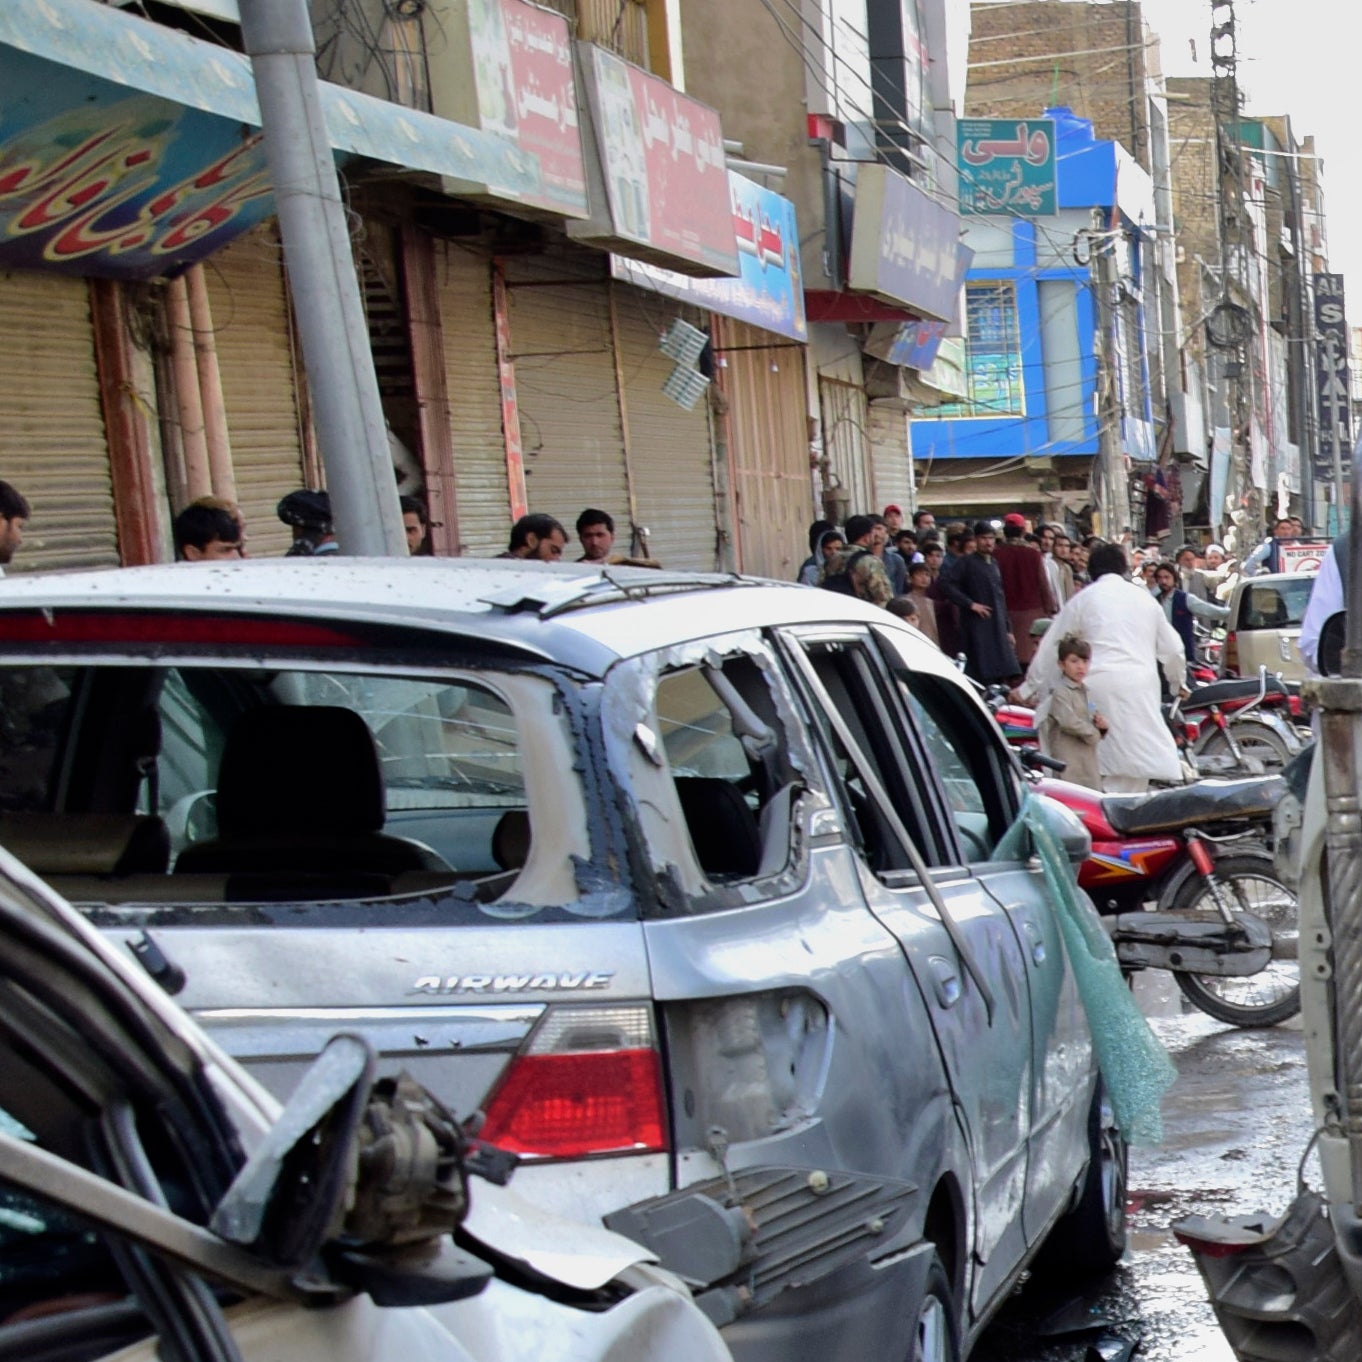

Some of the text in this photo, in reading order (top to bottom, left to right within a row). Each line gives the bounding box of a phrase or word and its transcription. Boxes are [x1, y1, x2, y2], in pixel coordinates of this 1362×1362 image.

[961, 122, 1050, 167] ولی
[1316, 277, 1344, 297] AL
[406, 970, 615, 995] AIRWAVE
